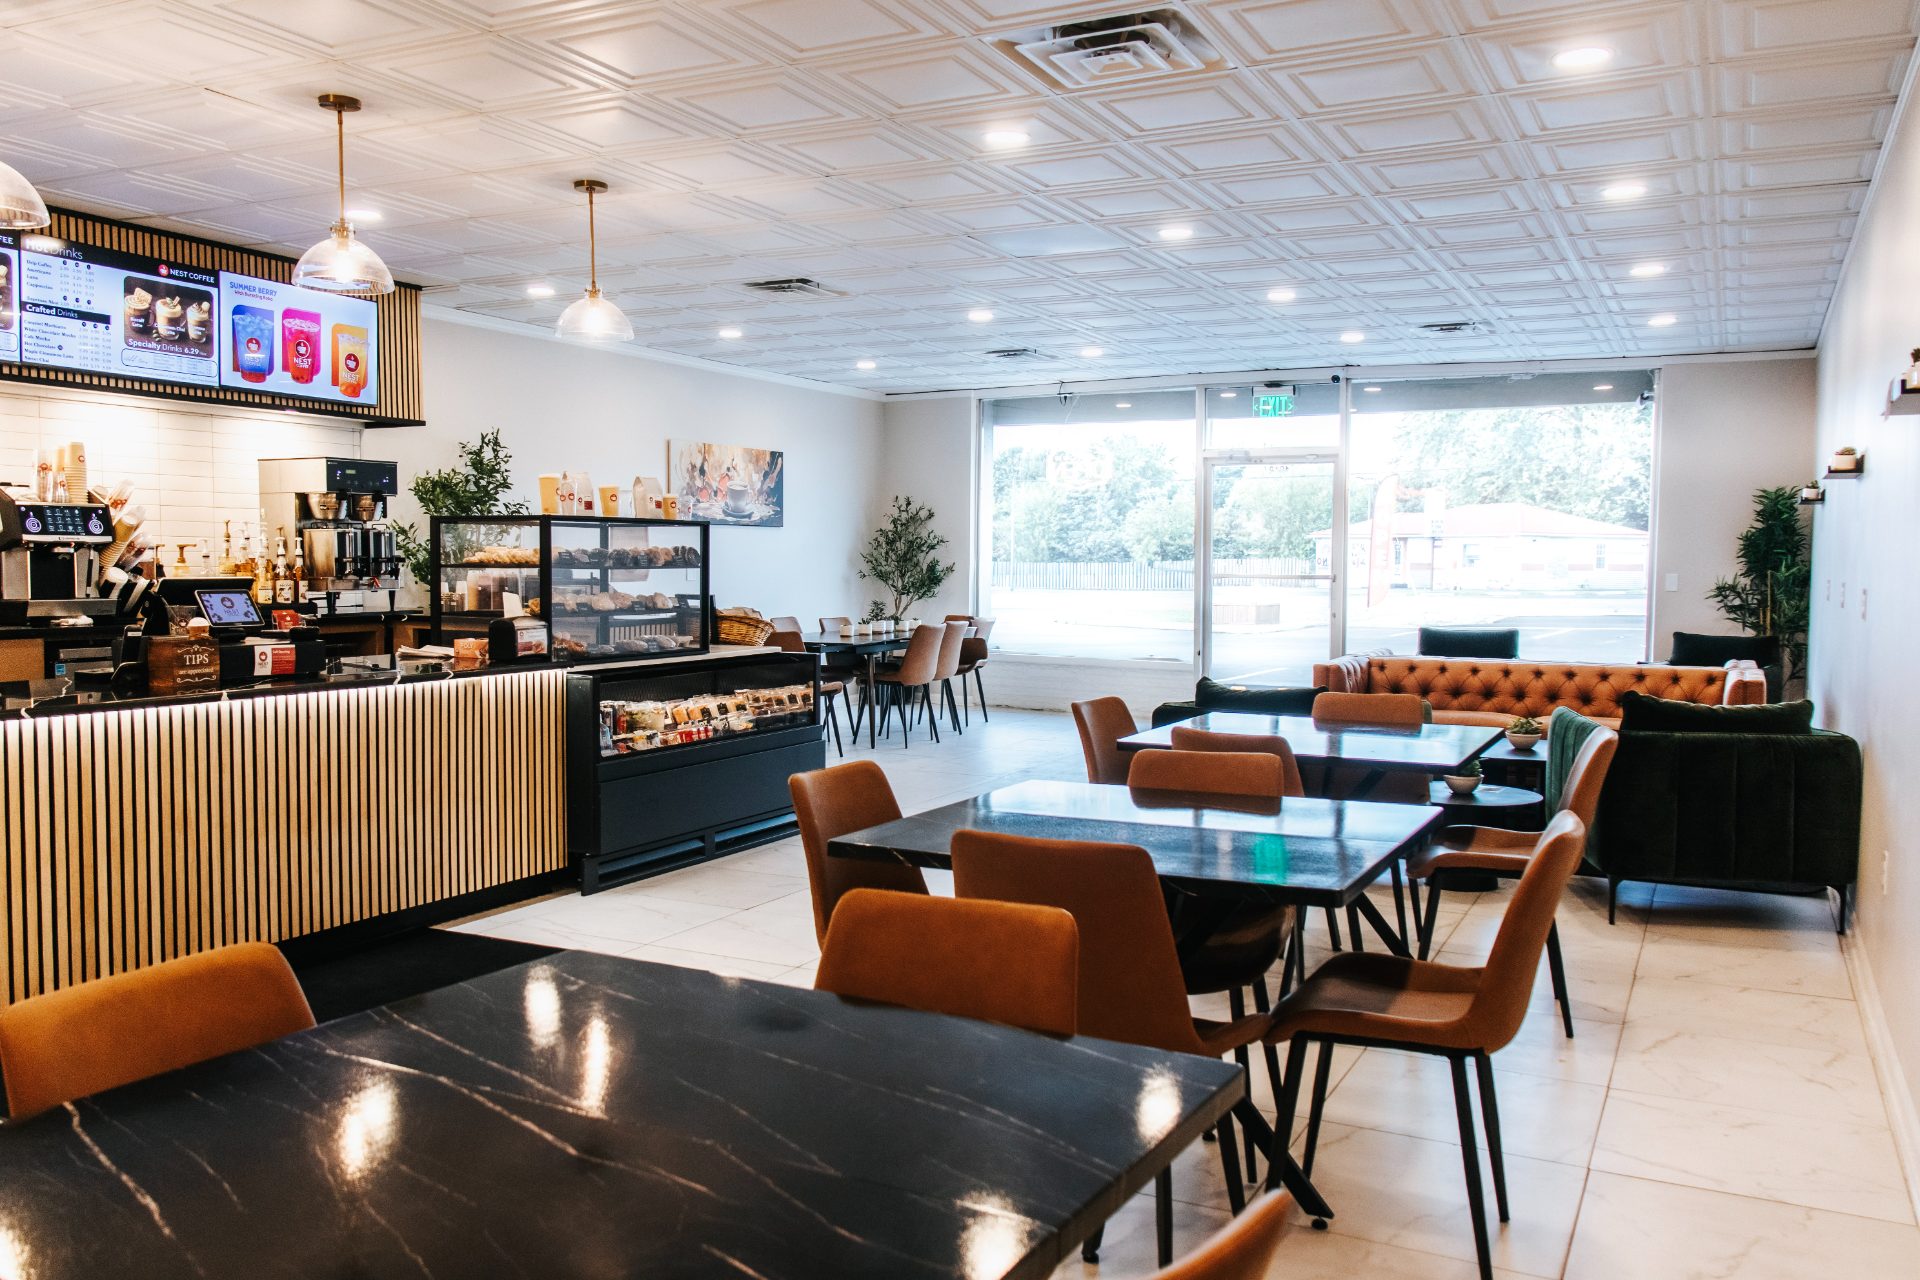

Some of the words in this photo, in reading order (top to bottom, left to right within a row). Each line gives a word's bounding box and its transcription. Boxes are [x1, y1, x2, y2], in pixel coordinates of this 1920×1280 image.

[50, 243, 83, 260] Drinks
[169, 268, 188, 278] NEST
[188, 273, 215, 284] COFFEE
[229, 281, 257, 293] SUMMER
[258, 287, 277, 297] BERRY
[26, 304, 56, 315] Crafted
[57, 308, 78, 319] Drinks
[128, 338, 161, 351] Specialty
[162, 344, 183, 353] Drinks
[293, 357, 312, 365] NEST
[343, 373, 360, 381] NEST
[1259, 396, 1289, 417] EXIT
[183, 653, 209, 665] TIPS
